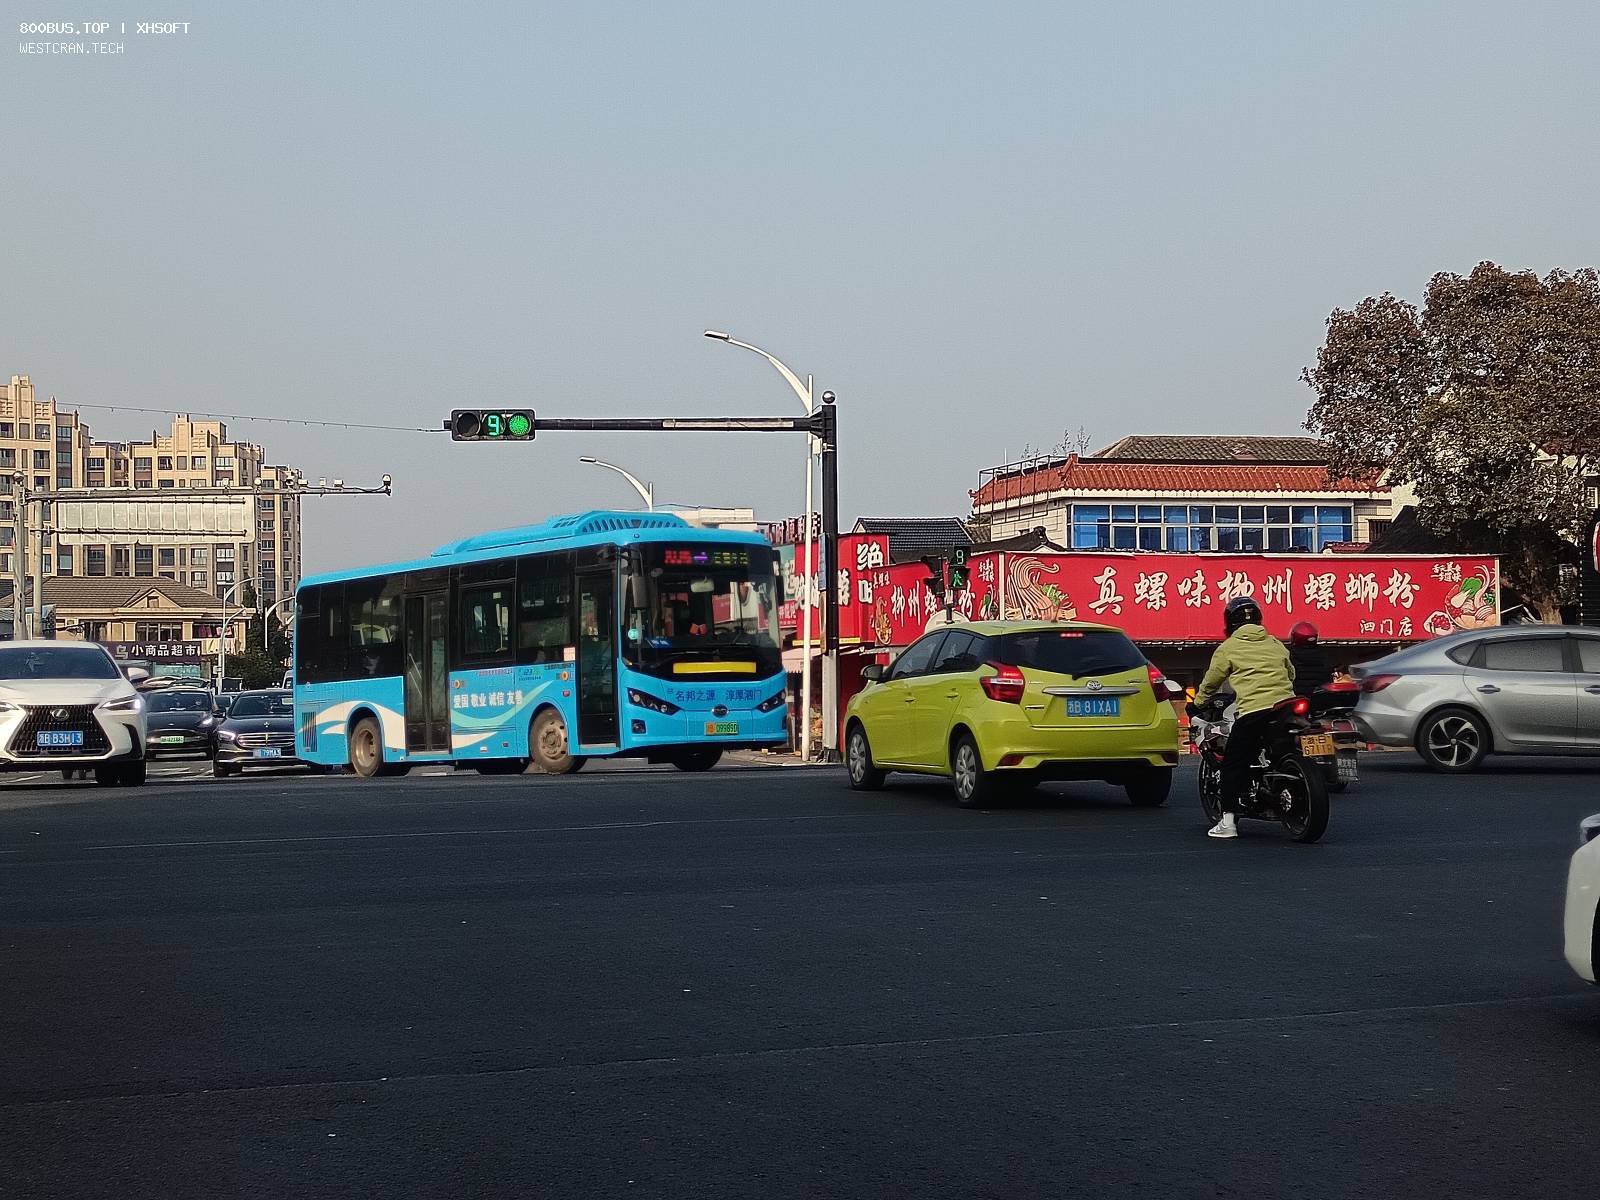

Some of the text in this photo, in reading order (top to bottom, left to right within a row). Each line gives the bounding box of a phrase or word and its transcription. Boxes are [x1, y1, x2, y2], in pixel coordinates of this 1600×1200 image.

[488, 415, 500, 436] 9
[891, 580, 975, 628] 柳州螺粉
[1088, 566, 1420, 615] 真螺味柳州螺蛳粉
[1359, 616, 1413, 637] 泗门店
